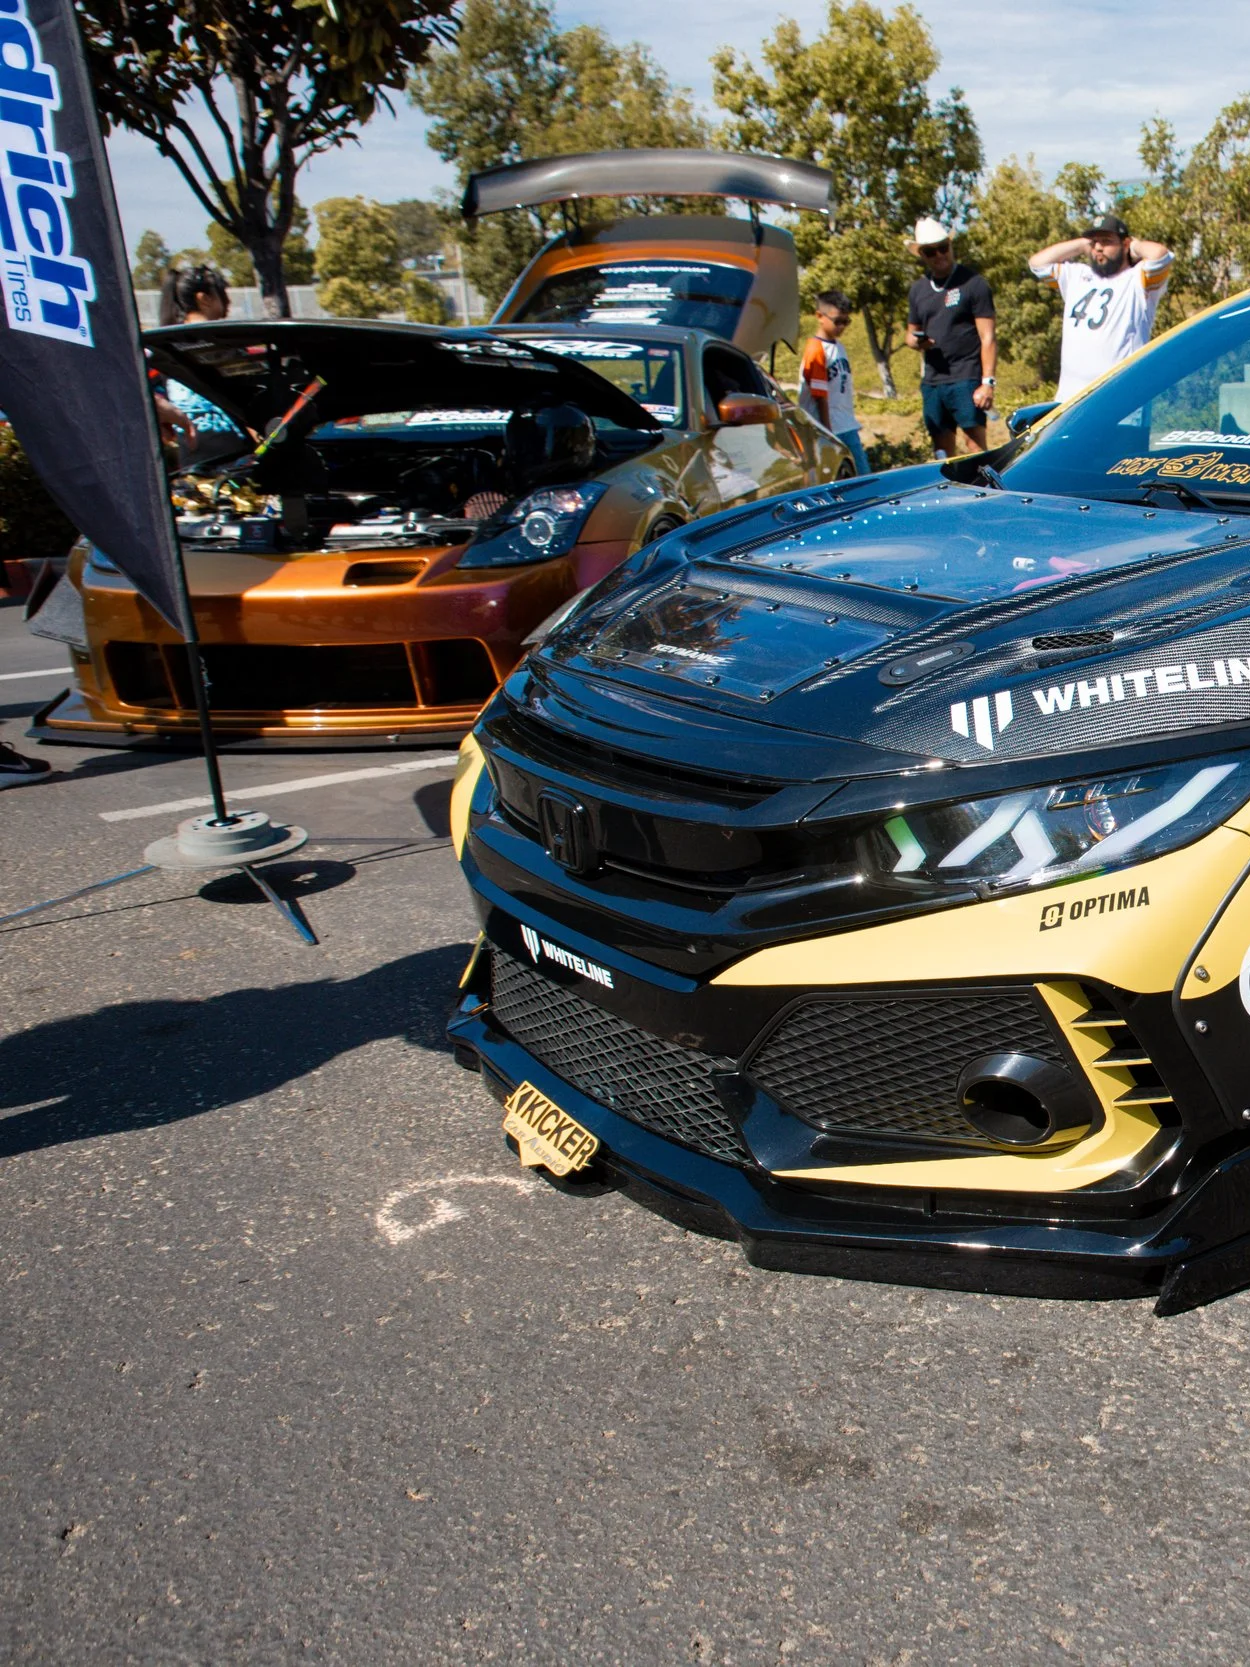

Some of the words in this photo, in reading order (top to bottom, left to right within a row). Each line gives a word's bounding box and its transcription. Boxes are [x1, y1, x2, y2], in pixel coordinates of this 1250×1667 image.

[0, 0, 87, 330] drich
[5, 254, 32, 323] Tires
[1068, 287, 1114, 330] 43
[1069, 886, 1150, 920] OPTIMA
[541, 938, 615, 989] WHITELINE
[520, 1093, 596, 1168] KICKER
